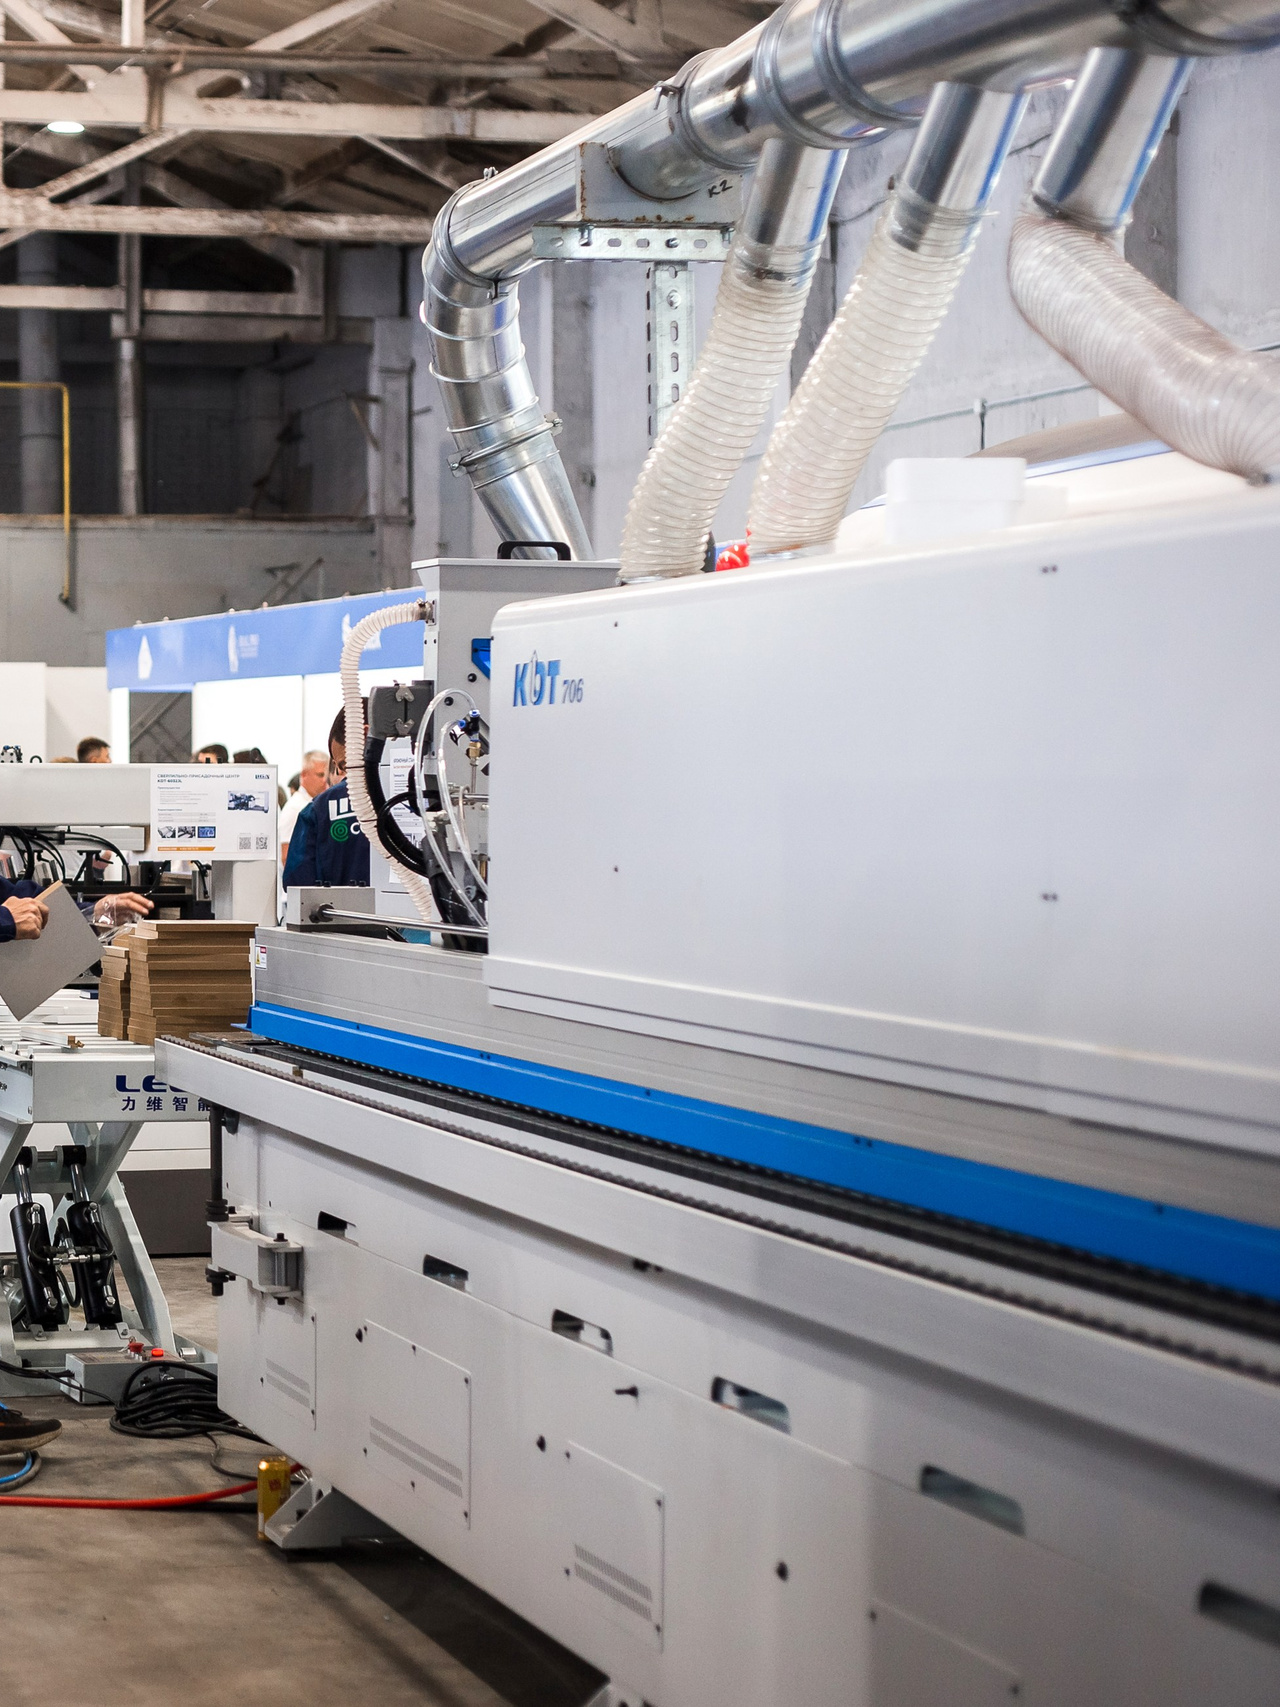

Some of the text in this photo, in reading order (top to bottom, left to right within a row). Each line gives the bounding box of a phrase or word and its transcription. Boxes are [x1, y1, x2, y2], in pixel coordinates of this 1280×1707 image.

[513, 650, 584, 707] KDT 706
[116, 1075, 187, 1093] LE
